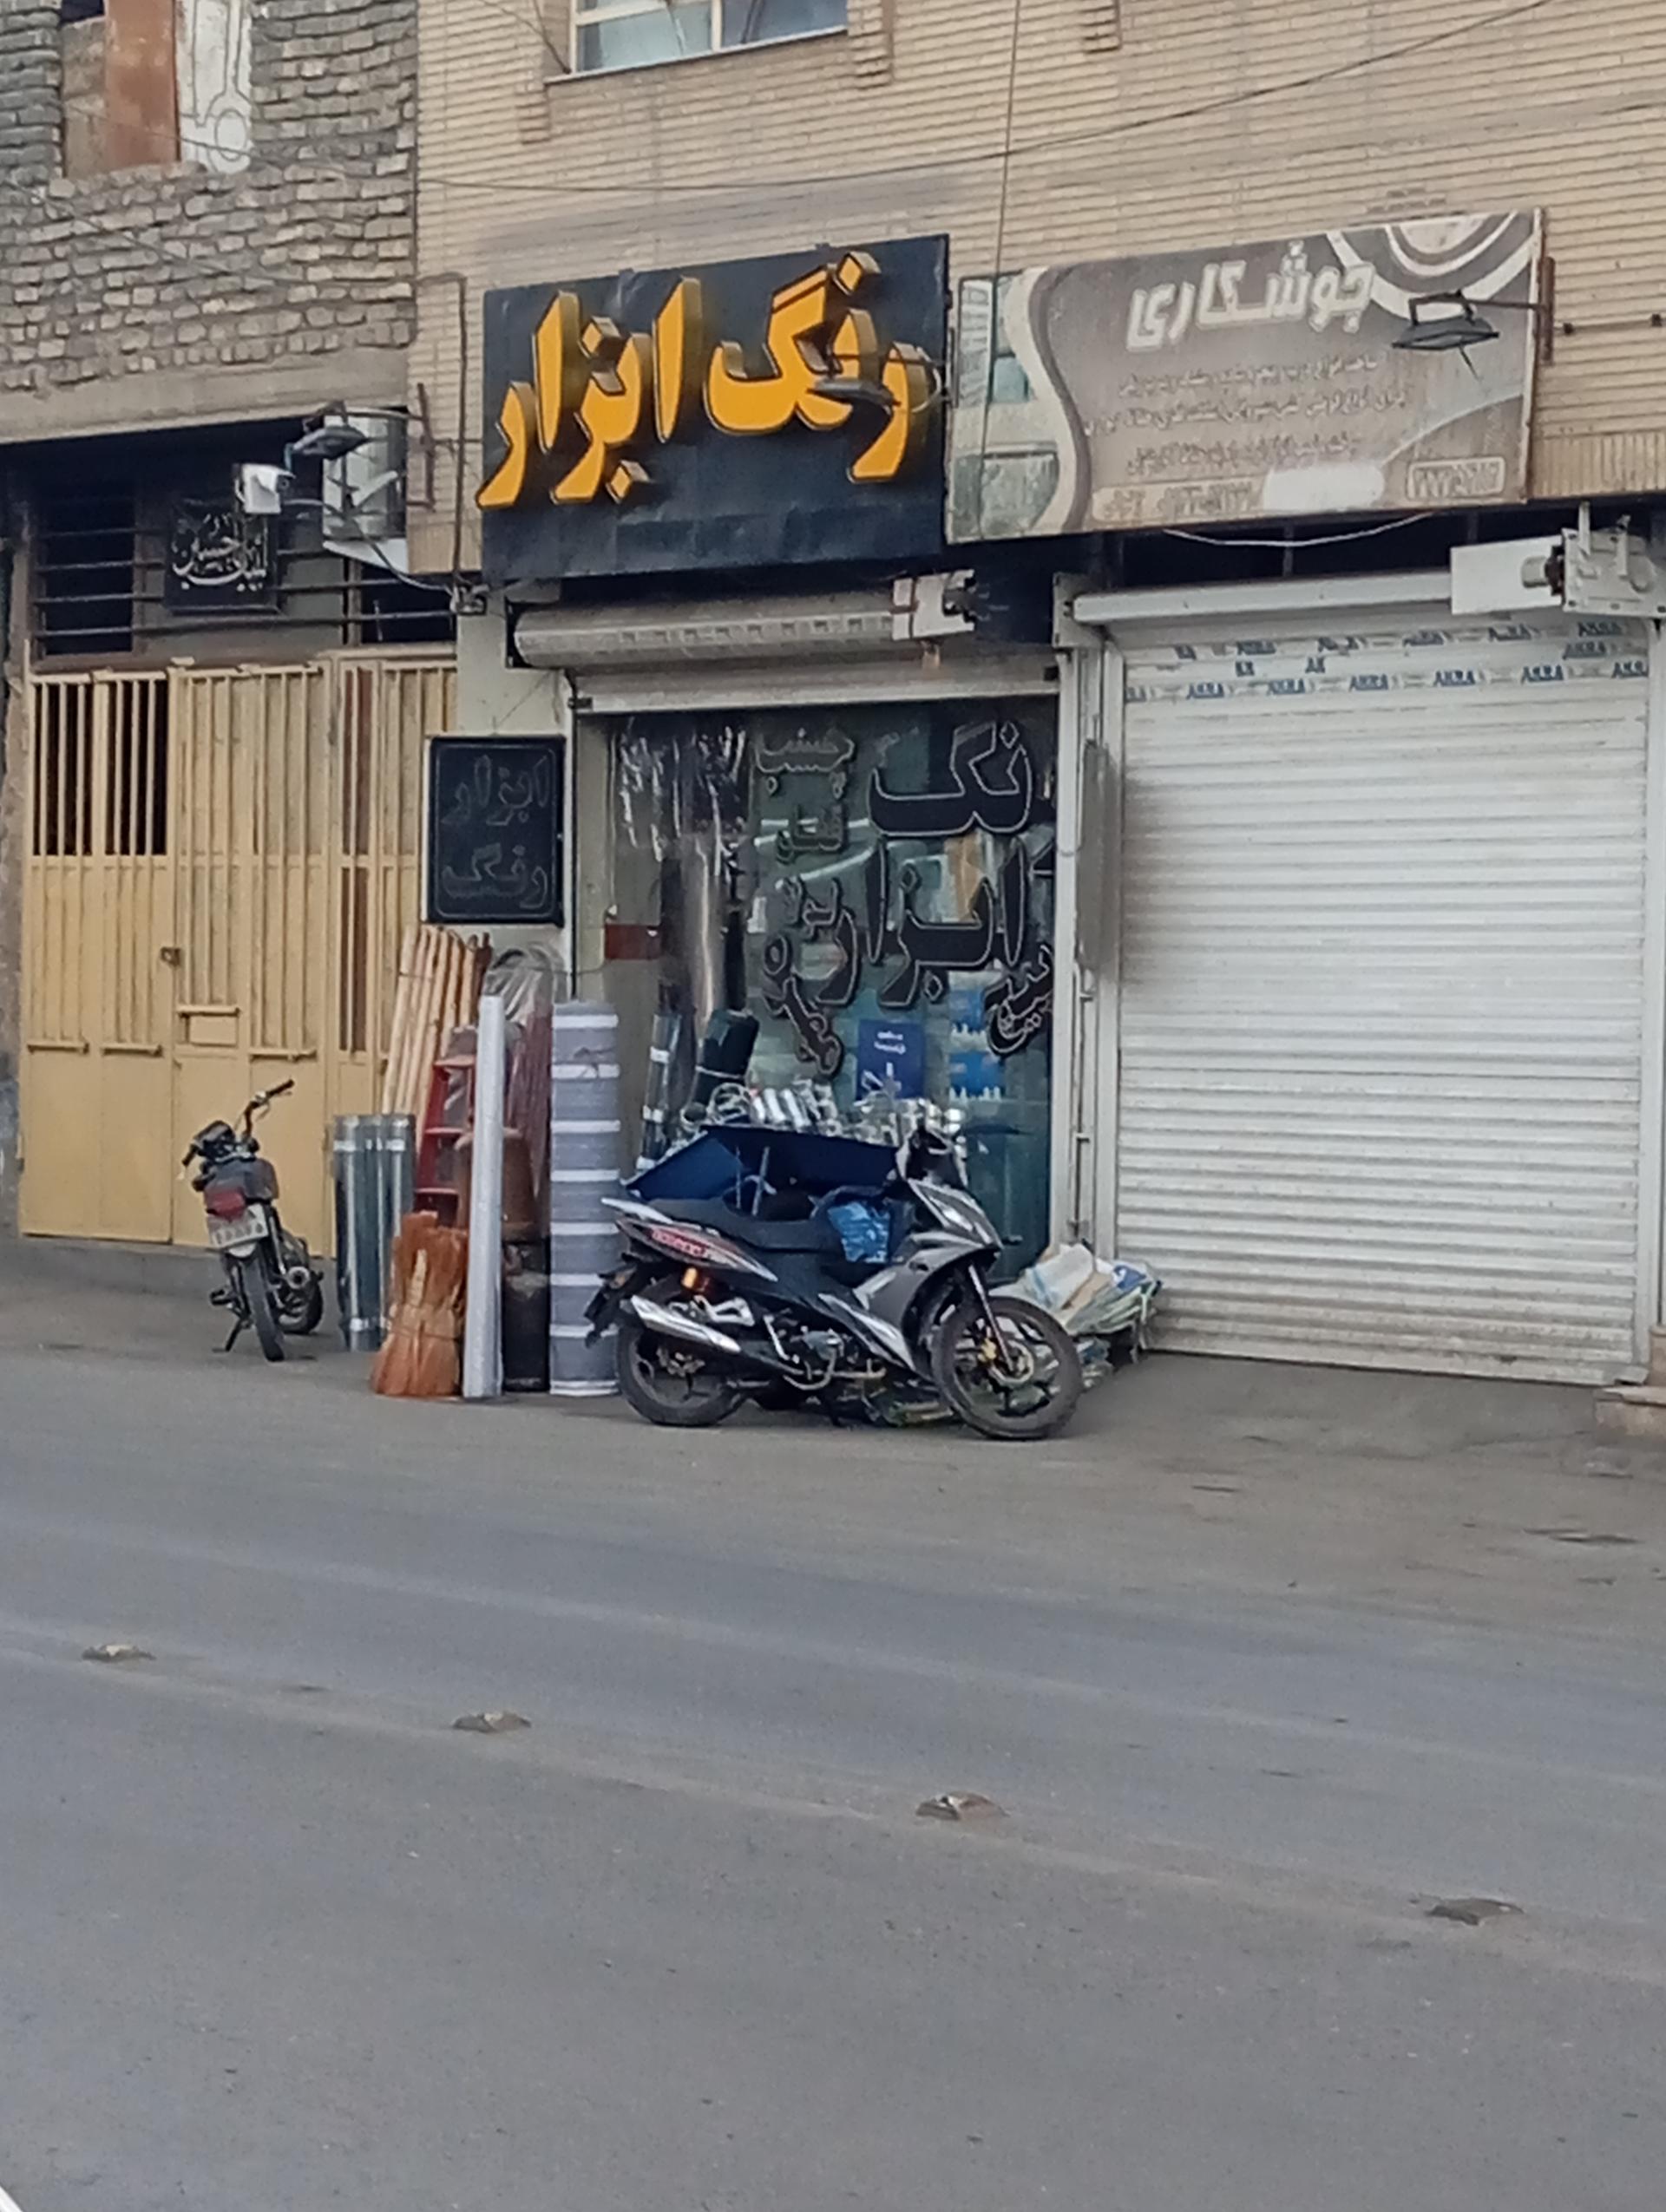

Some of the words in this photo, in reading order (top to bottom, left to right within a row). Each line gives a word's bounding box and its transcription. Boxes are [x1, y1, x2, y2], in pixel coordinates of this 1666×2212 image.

[1126, 240, 1377, 351] جوشکاری
[476, 276, 701, 510] ابزار
[705, 251, 930, 484] رنگ
[440, 753, 550, 826] ابزار
[441, 843, 548, 909] رنگ
[818, 837, 1026, 1006] ابزار
